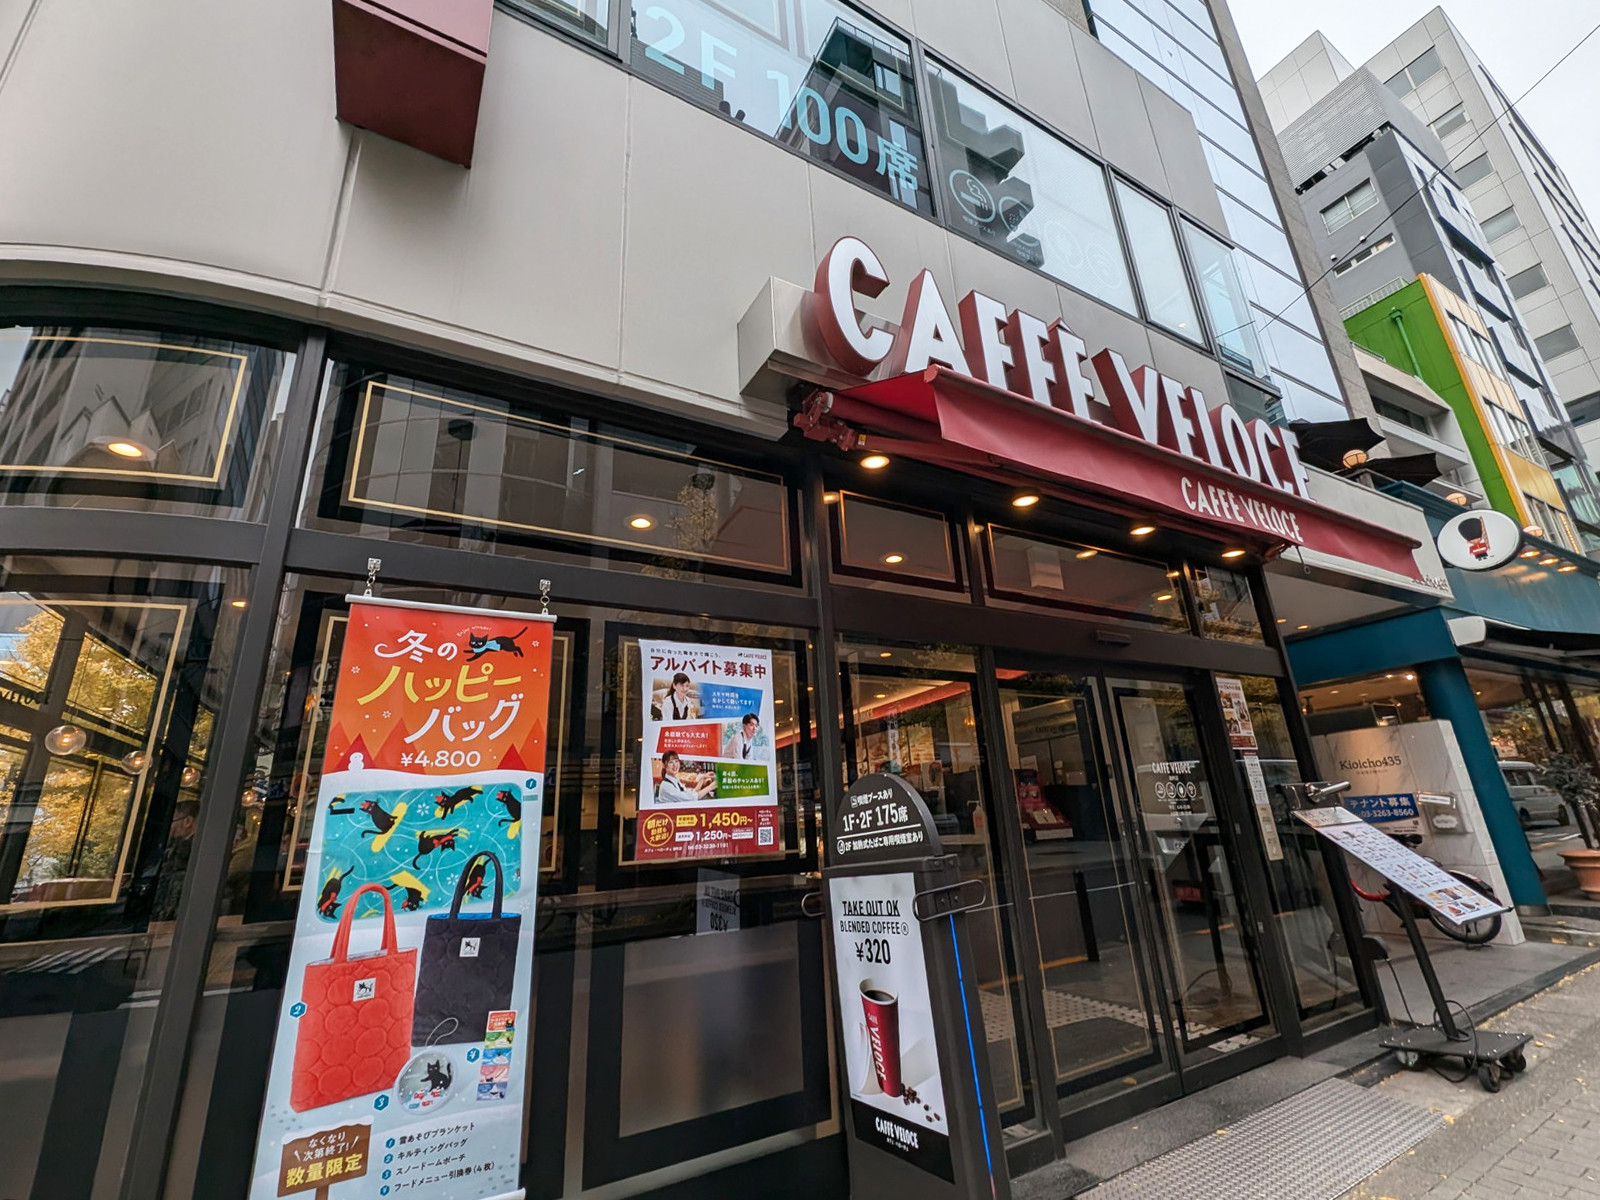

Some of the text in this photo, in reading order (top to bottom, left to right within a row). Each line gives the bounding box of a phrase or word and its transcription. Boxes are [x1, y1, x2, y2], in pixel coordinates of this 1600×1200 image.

[645, 5, 918, 191] 2F 100席
[1092, 347, 1316, 501] VELOCE
[1238, 494, 1304, 543] VELOCE
[374, 629, 458, 663] 冬の
[650, 655, 766, 680] アルバイト募集中
[357, 662, 522, 706] ハッピー
[403, 693, 524, 744] バッグ
[400, 750, 481, 768] ¥4,800
[1339, 755, 1402, 771] Kioicho435
[875, 803, 909, 827] 175席
[842, 900, 900, 916] TAKE OUT OK
[840, 920, 870, 934] BLENDED
[855, 938, 891, 965] ¥320
[868, 1025, 887, 1081] VELOCE
[309, 1131, 346, 1148] なくなり
[397, 1138, 468, 1160] キルティングバッグ
[894, 1124, 919, 1149] VELOCE
[303, 1142, 349, 1162] 次第終了!
[395, 1153, 466, 1176] スノードームポーチ
[286, 1153, 363, 1188] 数量限定
